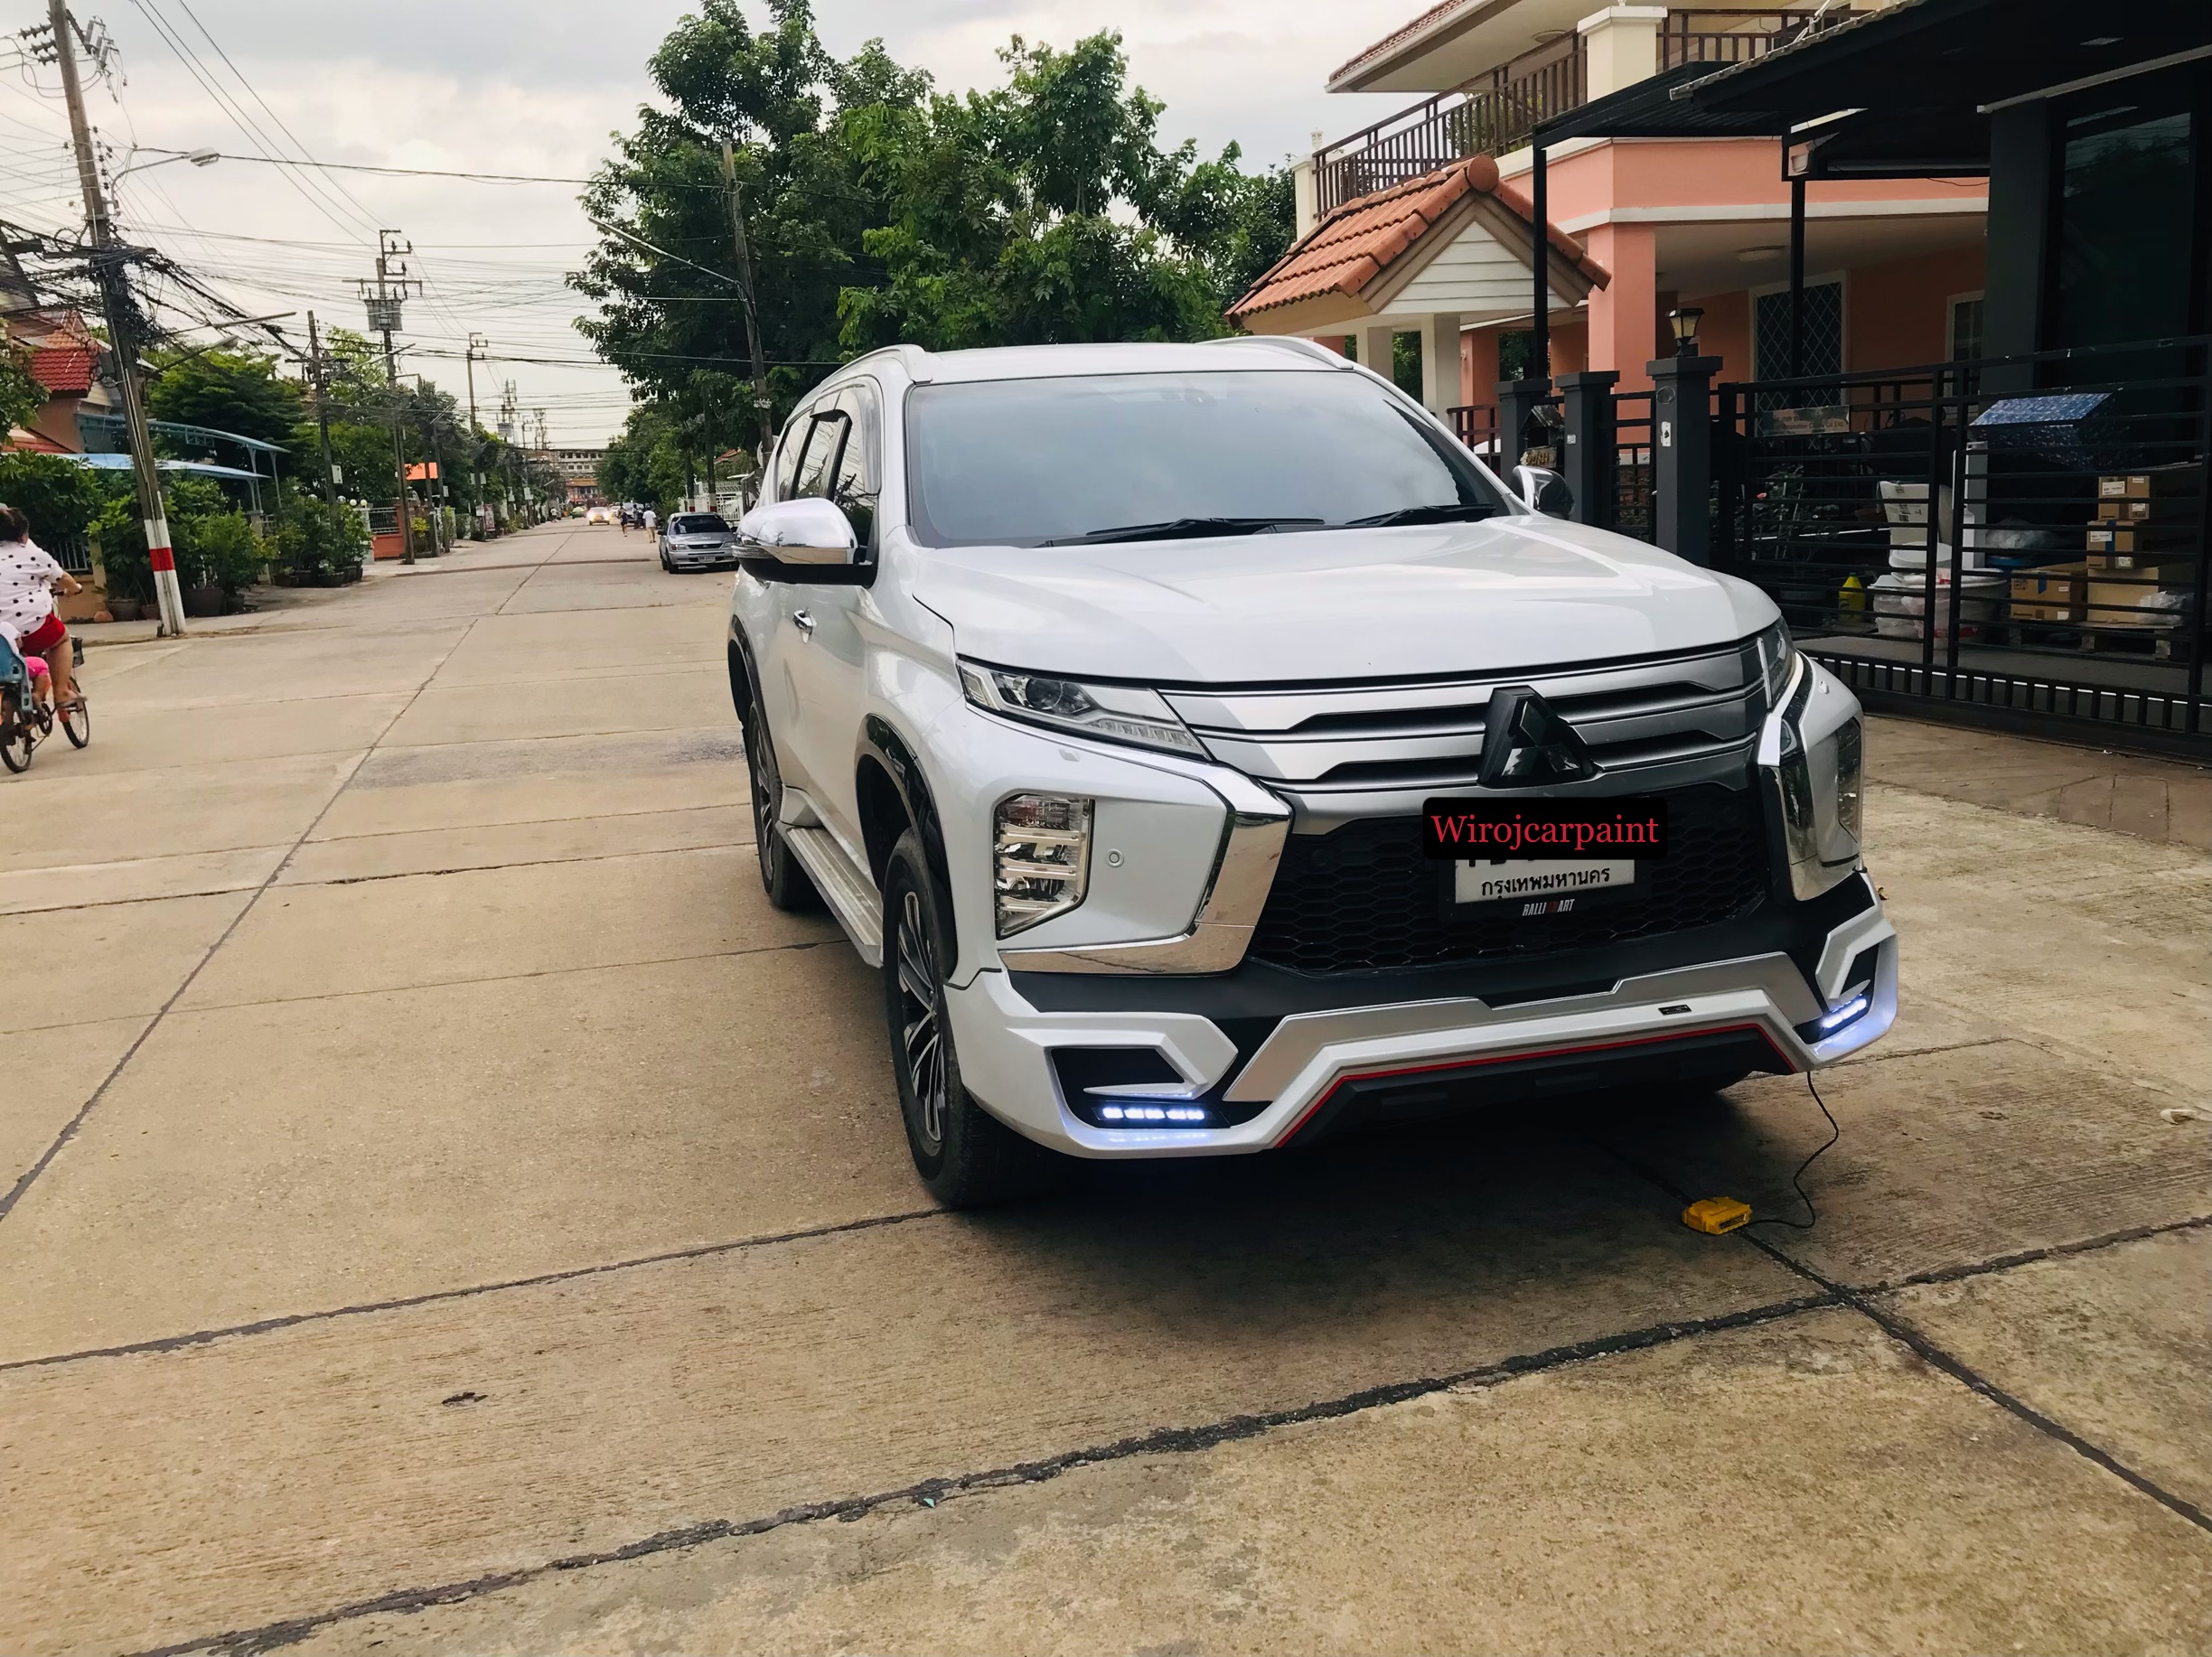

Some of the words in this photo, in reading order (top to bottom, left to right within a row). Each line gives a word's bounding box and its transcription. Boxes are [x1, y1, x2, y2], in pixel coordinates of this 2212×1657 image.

[1481, 867, 1610, 899] กรุงเทพมหานคร
